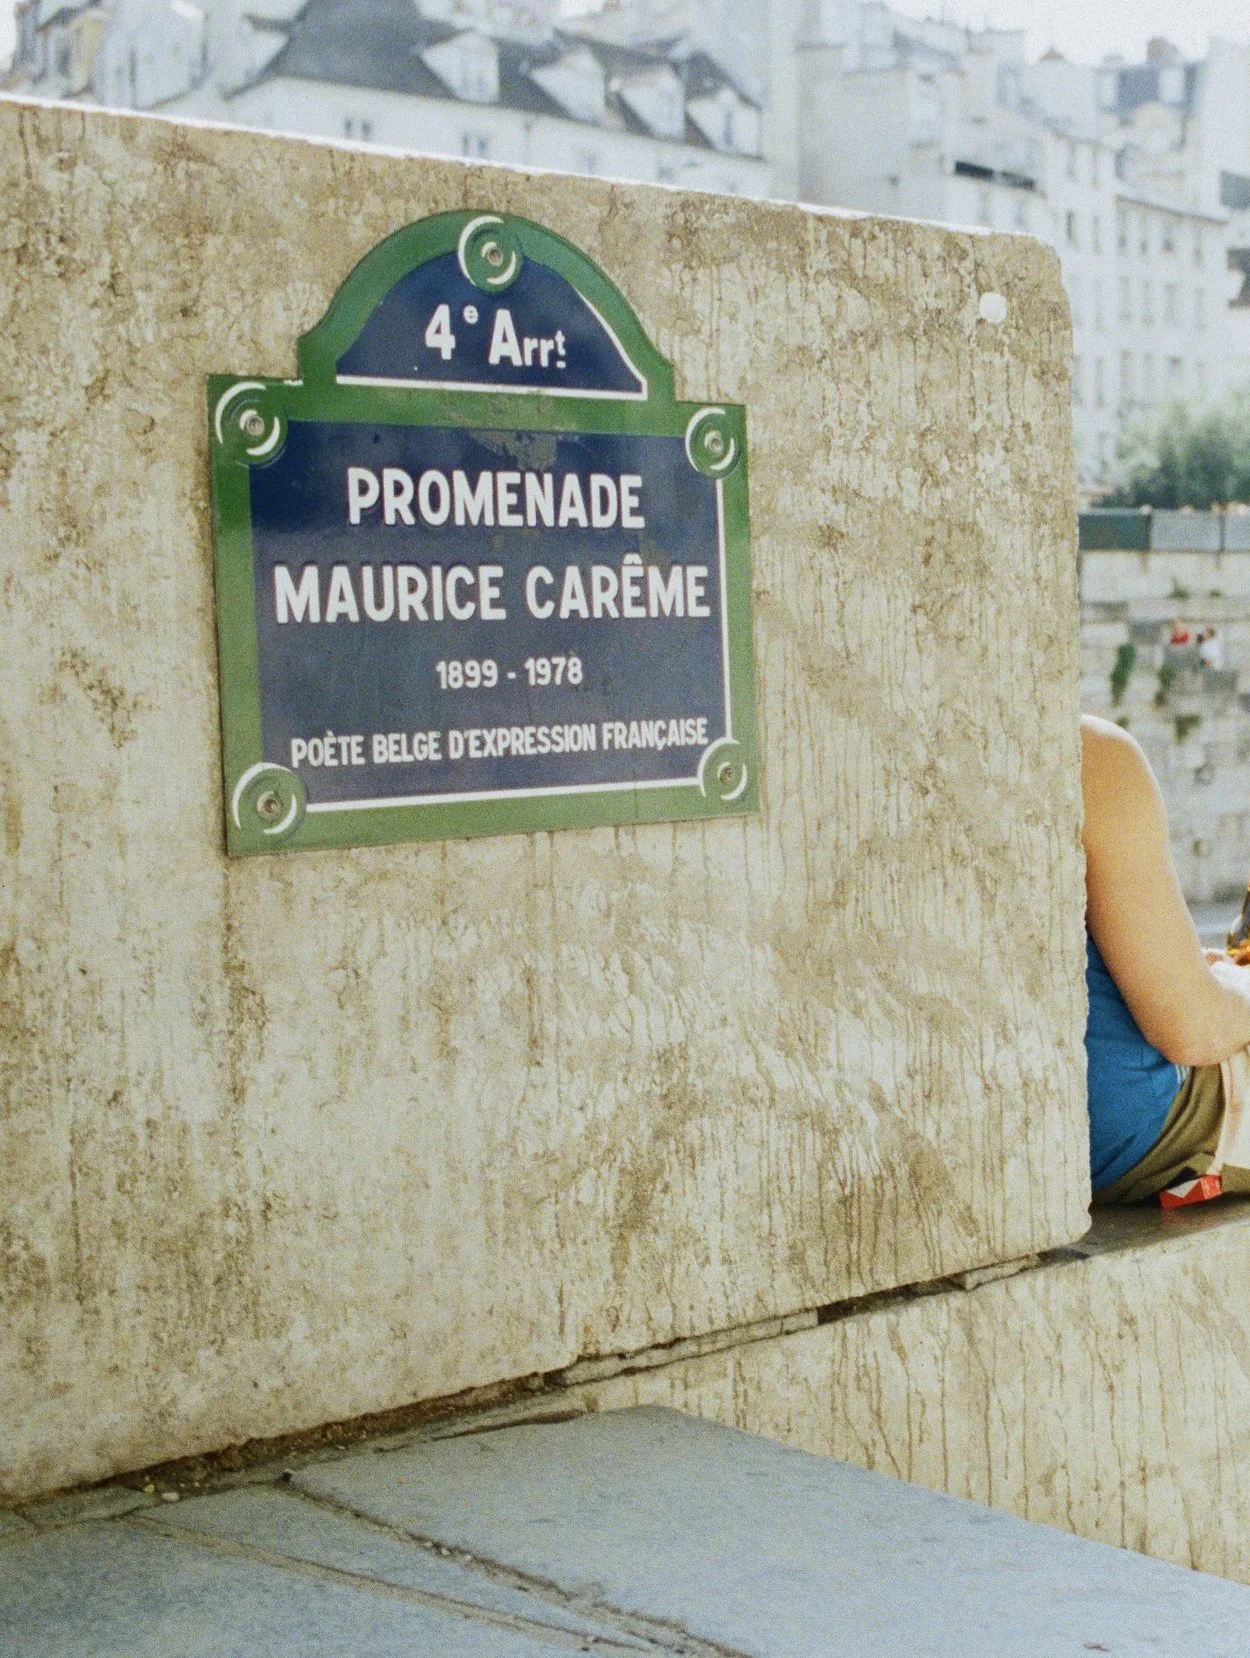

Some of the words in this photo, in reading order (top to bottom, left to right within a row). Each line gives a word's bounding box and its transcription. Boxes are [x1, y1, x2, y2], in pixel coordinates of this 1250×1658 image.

[348, 468, 646, 529] PROMENADE
[274, 565, 507, 624] MAURICE
[526, 554, 711, 619] CARÊME
[436, 659, 499, 690] 1899
[524, 656, 583, 686] 1978
[290, 730, 366, 768] POÈTE
[371, 730, 442, 764] BELGE
[448, 722, 598, 760] D'EXPRESSION
[601, 716, 709, 752] FRANÇAISE
